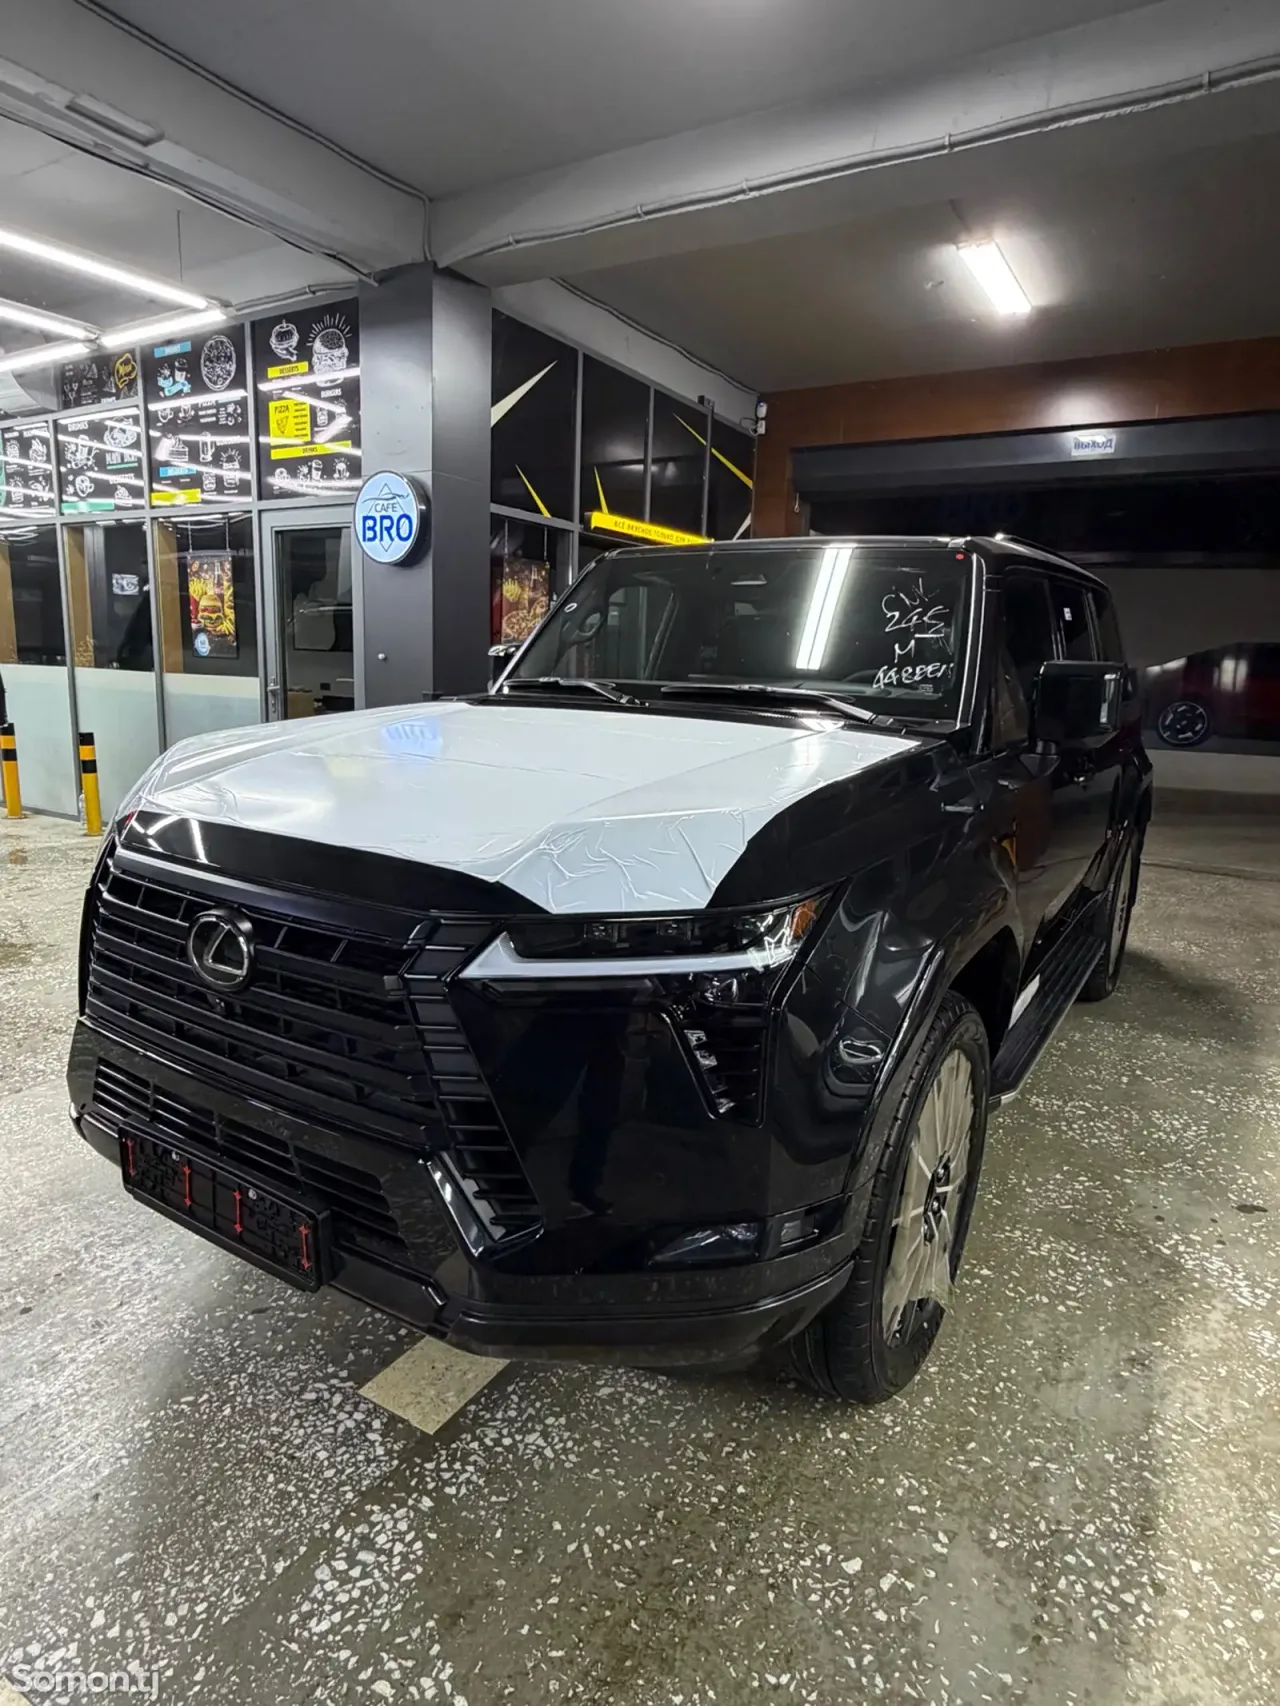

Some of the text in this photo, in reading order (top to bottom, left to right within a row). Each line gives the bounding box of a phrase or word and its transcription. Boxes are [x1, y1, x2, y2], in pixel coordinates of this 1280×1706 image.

[274, 404, 290, 415] PIZZA
[374, 502, 399, 513] CAFE
[362, 513, 413, 542] BRO
